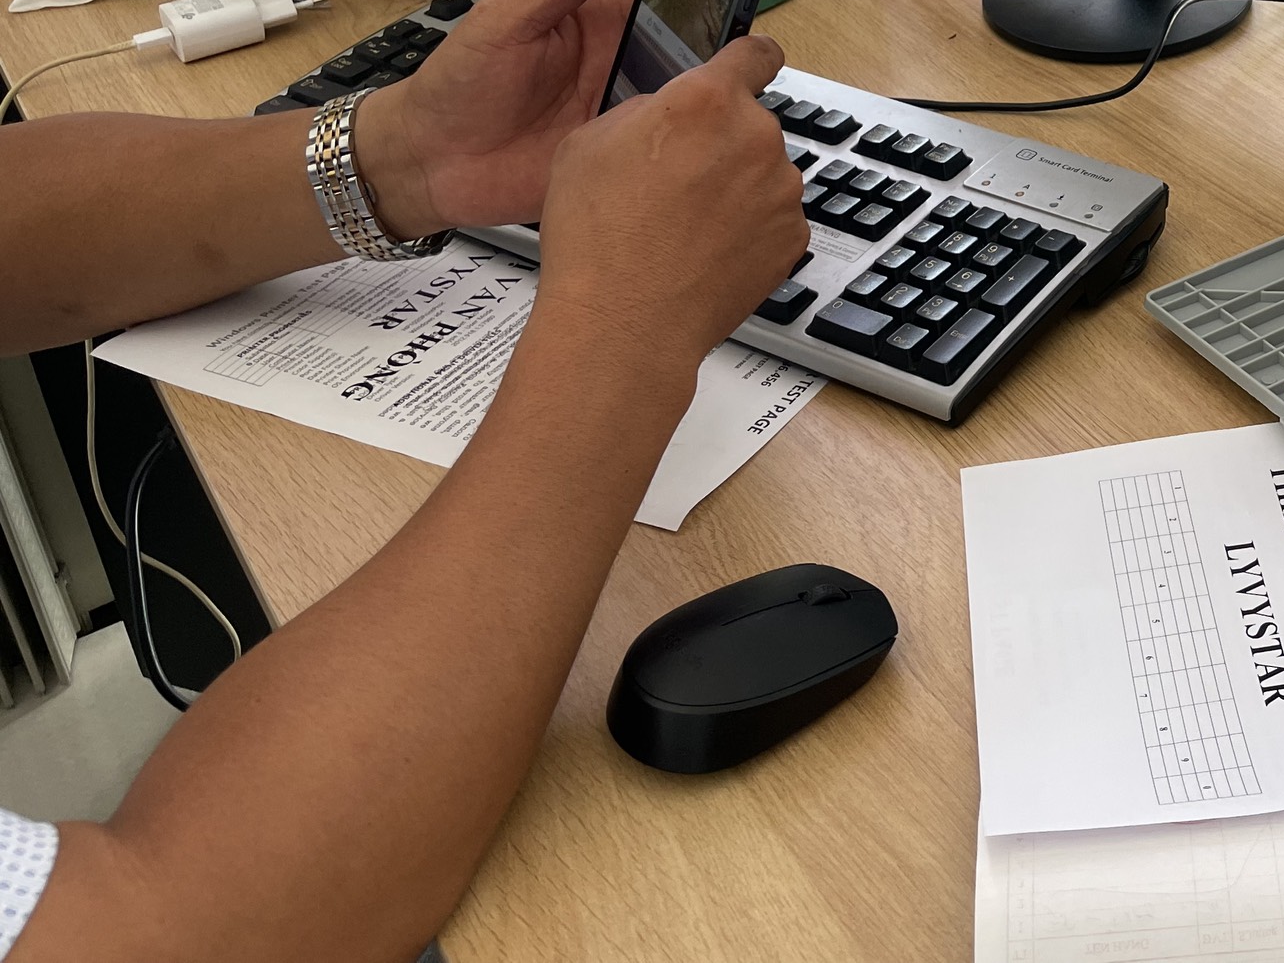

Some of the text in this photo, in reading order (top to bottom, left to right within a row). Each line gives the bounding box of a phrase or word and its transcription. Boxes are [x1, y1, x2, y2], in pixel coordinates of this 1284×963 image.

[406, 52, 417, 60] Q
[1038, 155, 1114, 184] Smart Card Terminal
[369, 247, 499, 332] VYSTAR
[747, 380, 814, 435] TEST PAGE
